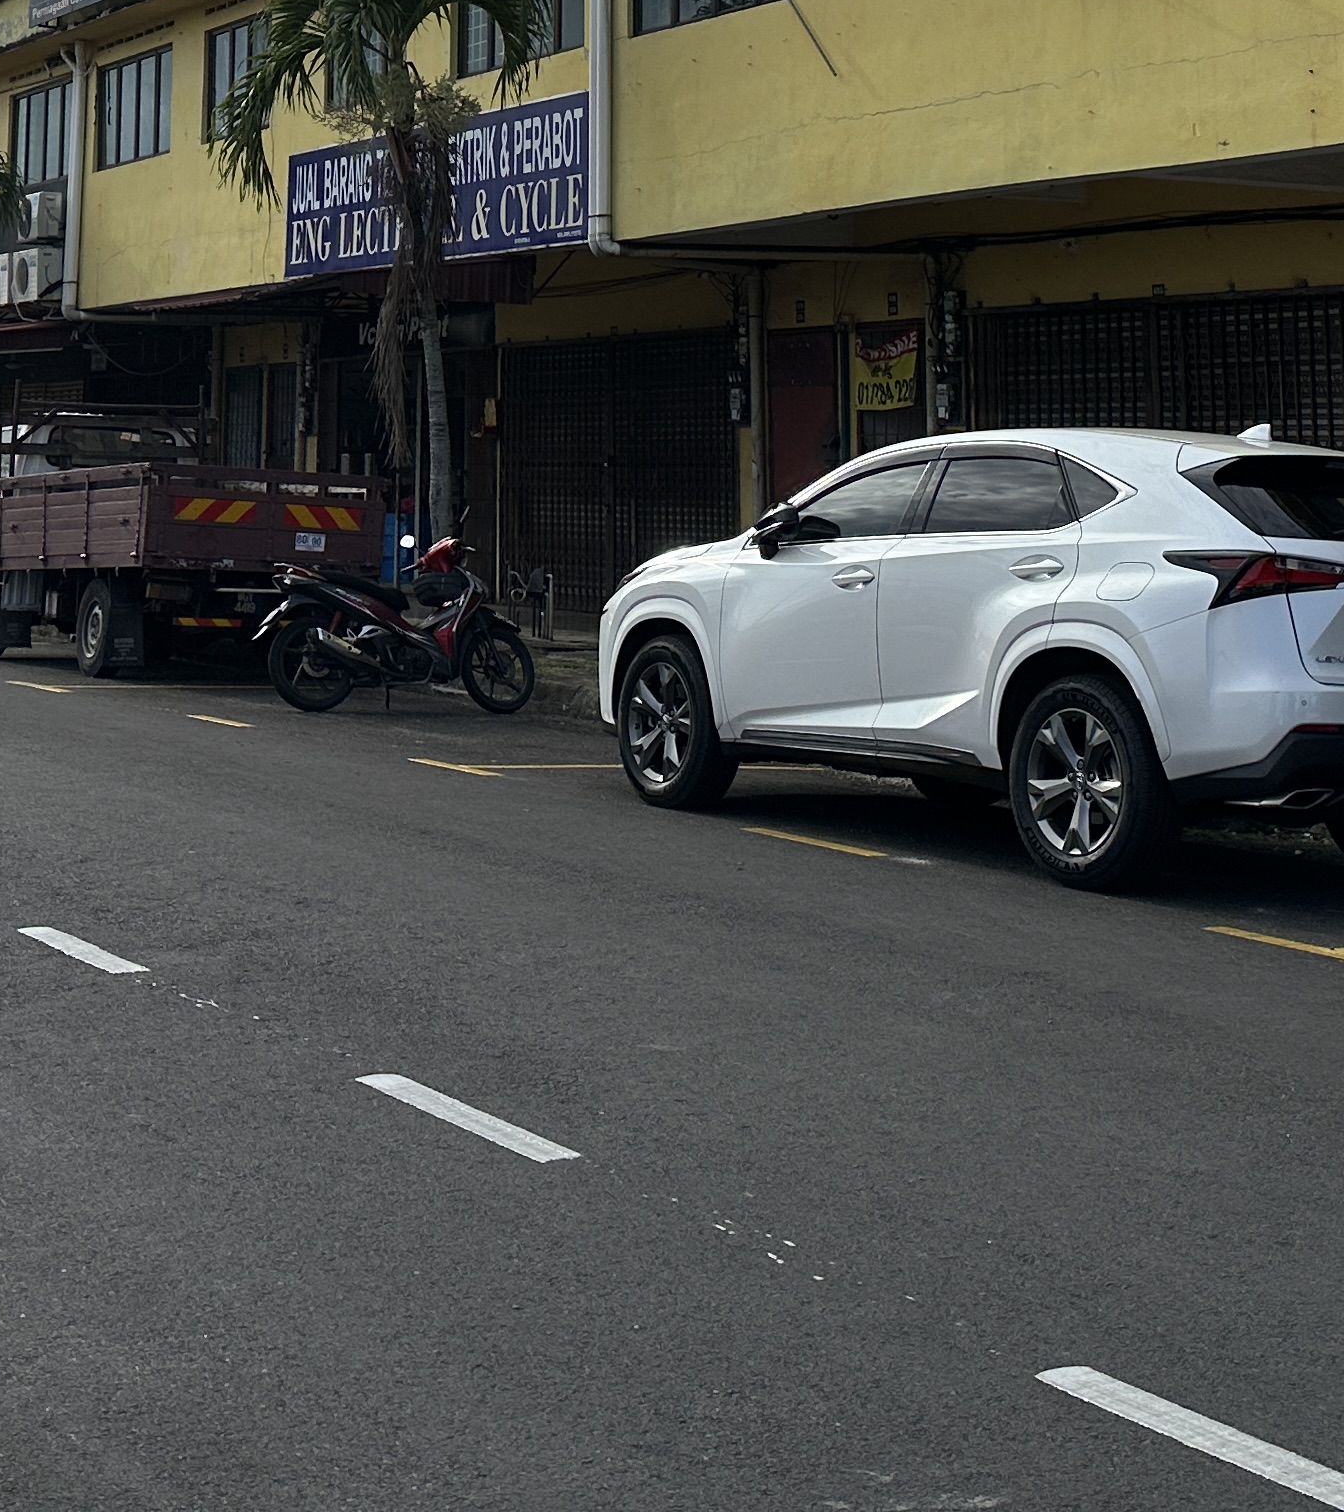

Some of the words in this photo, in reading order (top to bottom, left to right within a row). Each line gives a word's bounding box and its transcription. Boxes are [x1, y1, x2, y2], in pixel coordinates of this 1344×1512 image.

[292, 162, 320, 214] JUAL
[323, 150, 373, 209] BARANG
[499, 122, 511, 178] &
[513, 107, 584, 176] PERABOT
[290, 215, 332, 265] ENG
[470, 189, 491, 241] &
[499, 173, 584, 238] CYCLE
